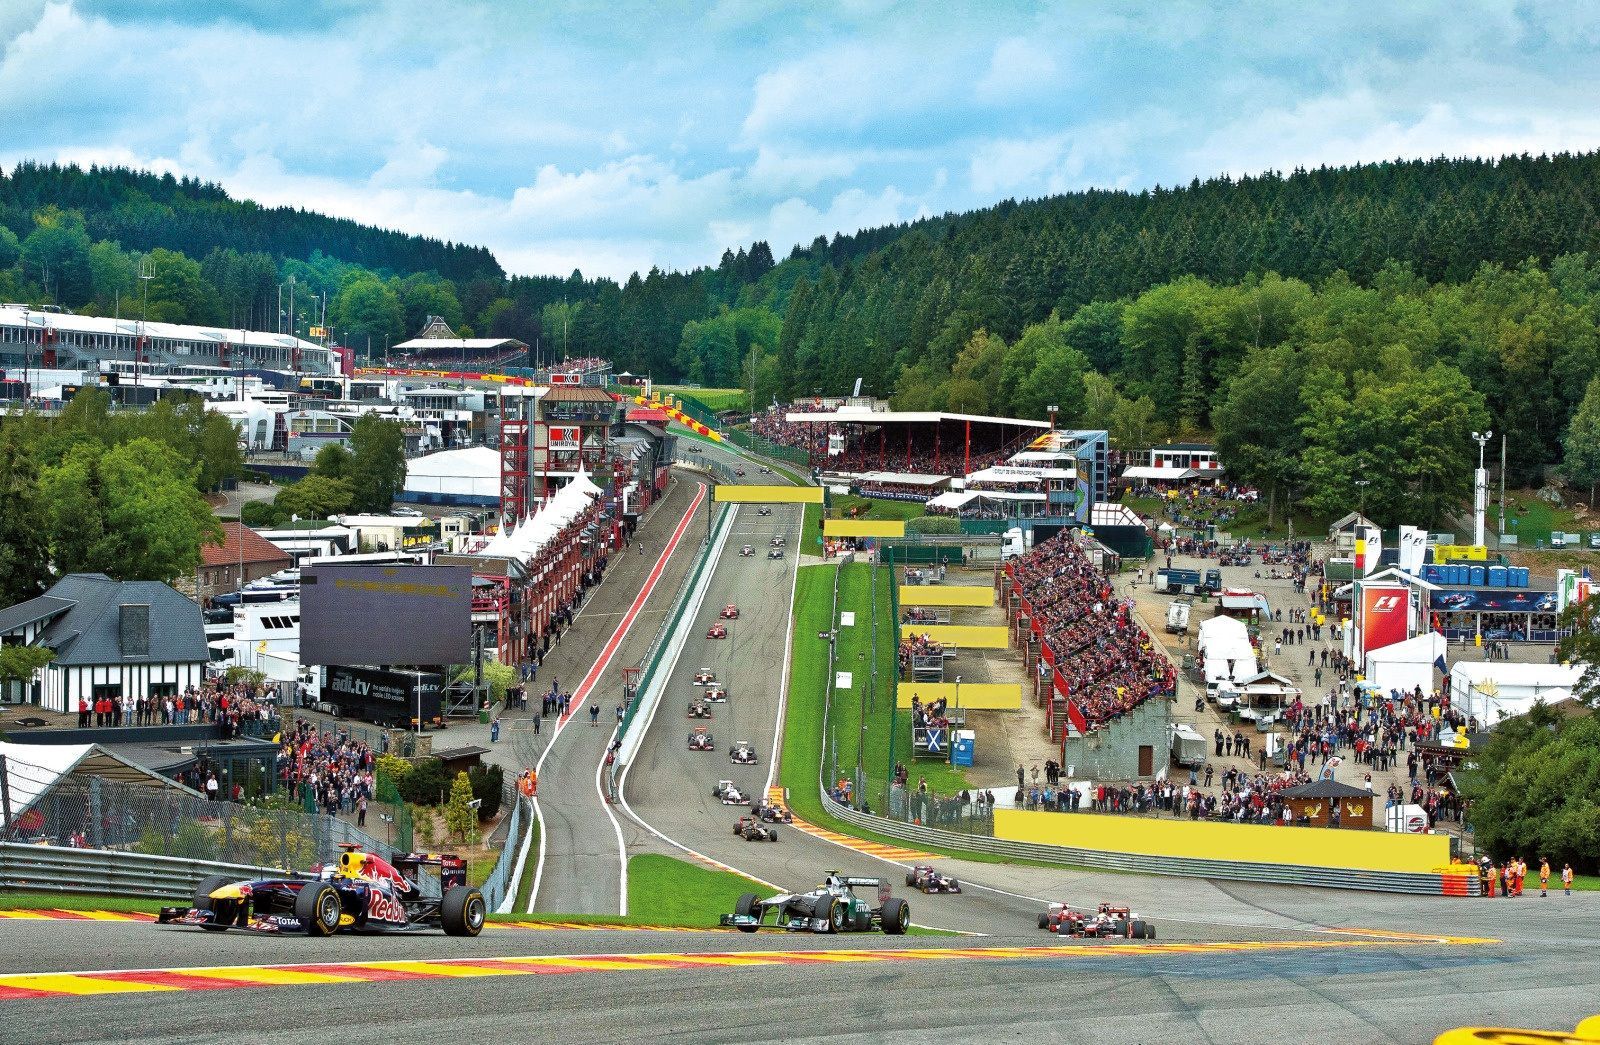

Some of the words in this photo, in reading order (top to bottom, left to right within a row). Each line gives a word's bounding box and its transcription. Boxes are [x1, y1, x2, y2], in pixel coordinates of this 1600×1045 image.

[1374, 596, 1401, 608] F1
[332, 676, 371, 696] adi.tv
[368, 889, 393, 919] Red
[276, 916, 301, 926] TOTAL
